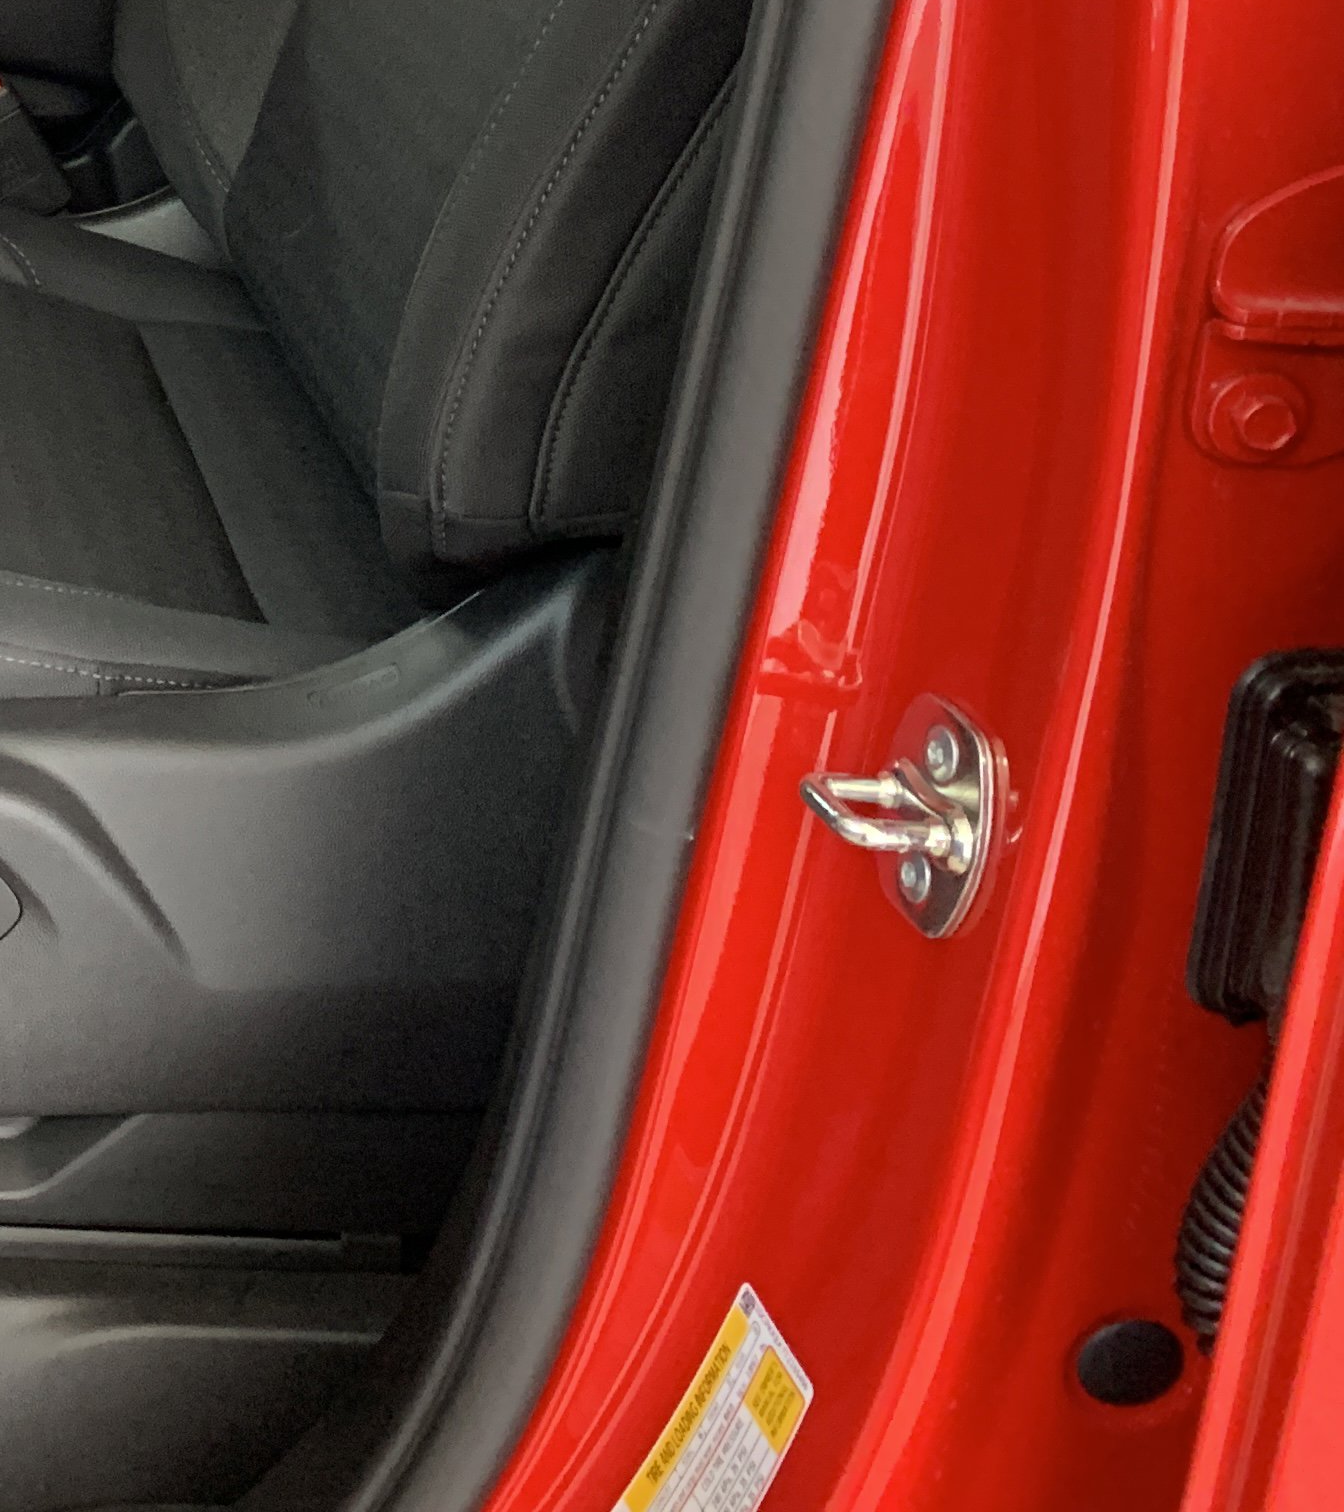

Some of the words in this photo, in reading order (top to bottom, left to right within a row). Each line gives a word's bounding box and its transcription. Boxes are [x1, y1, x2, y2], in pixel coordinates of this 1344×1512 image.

[646, 1460, 664, 1484] TIRE
[660, 1441, 675, 1465] AND
[672, 1401, 699, 1448] LOADING
[694, 1344, 731, 1406] INFORMATION
